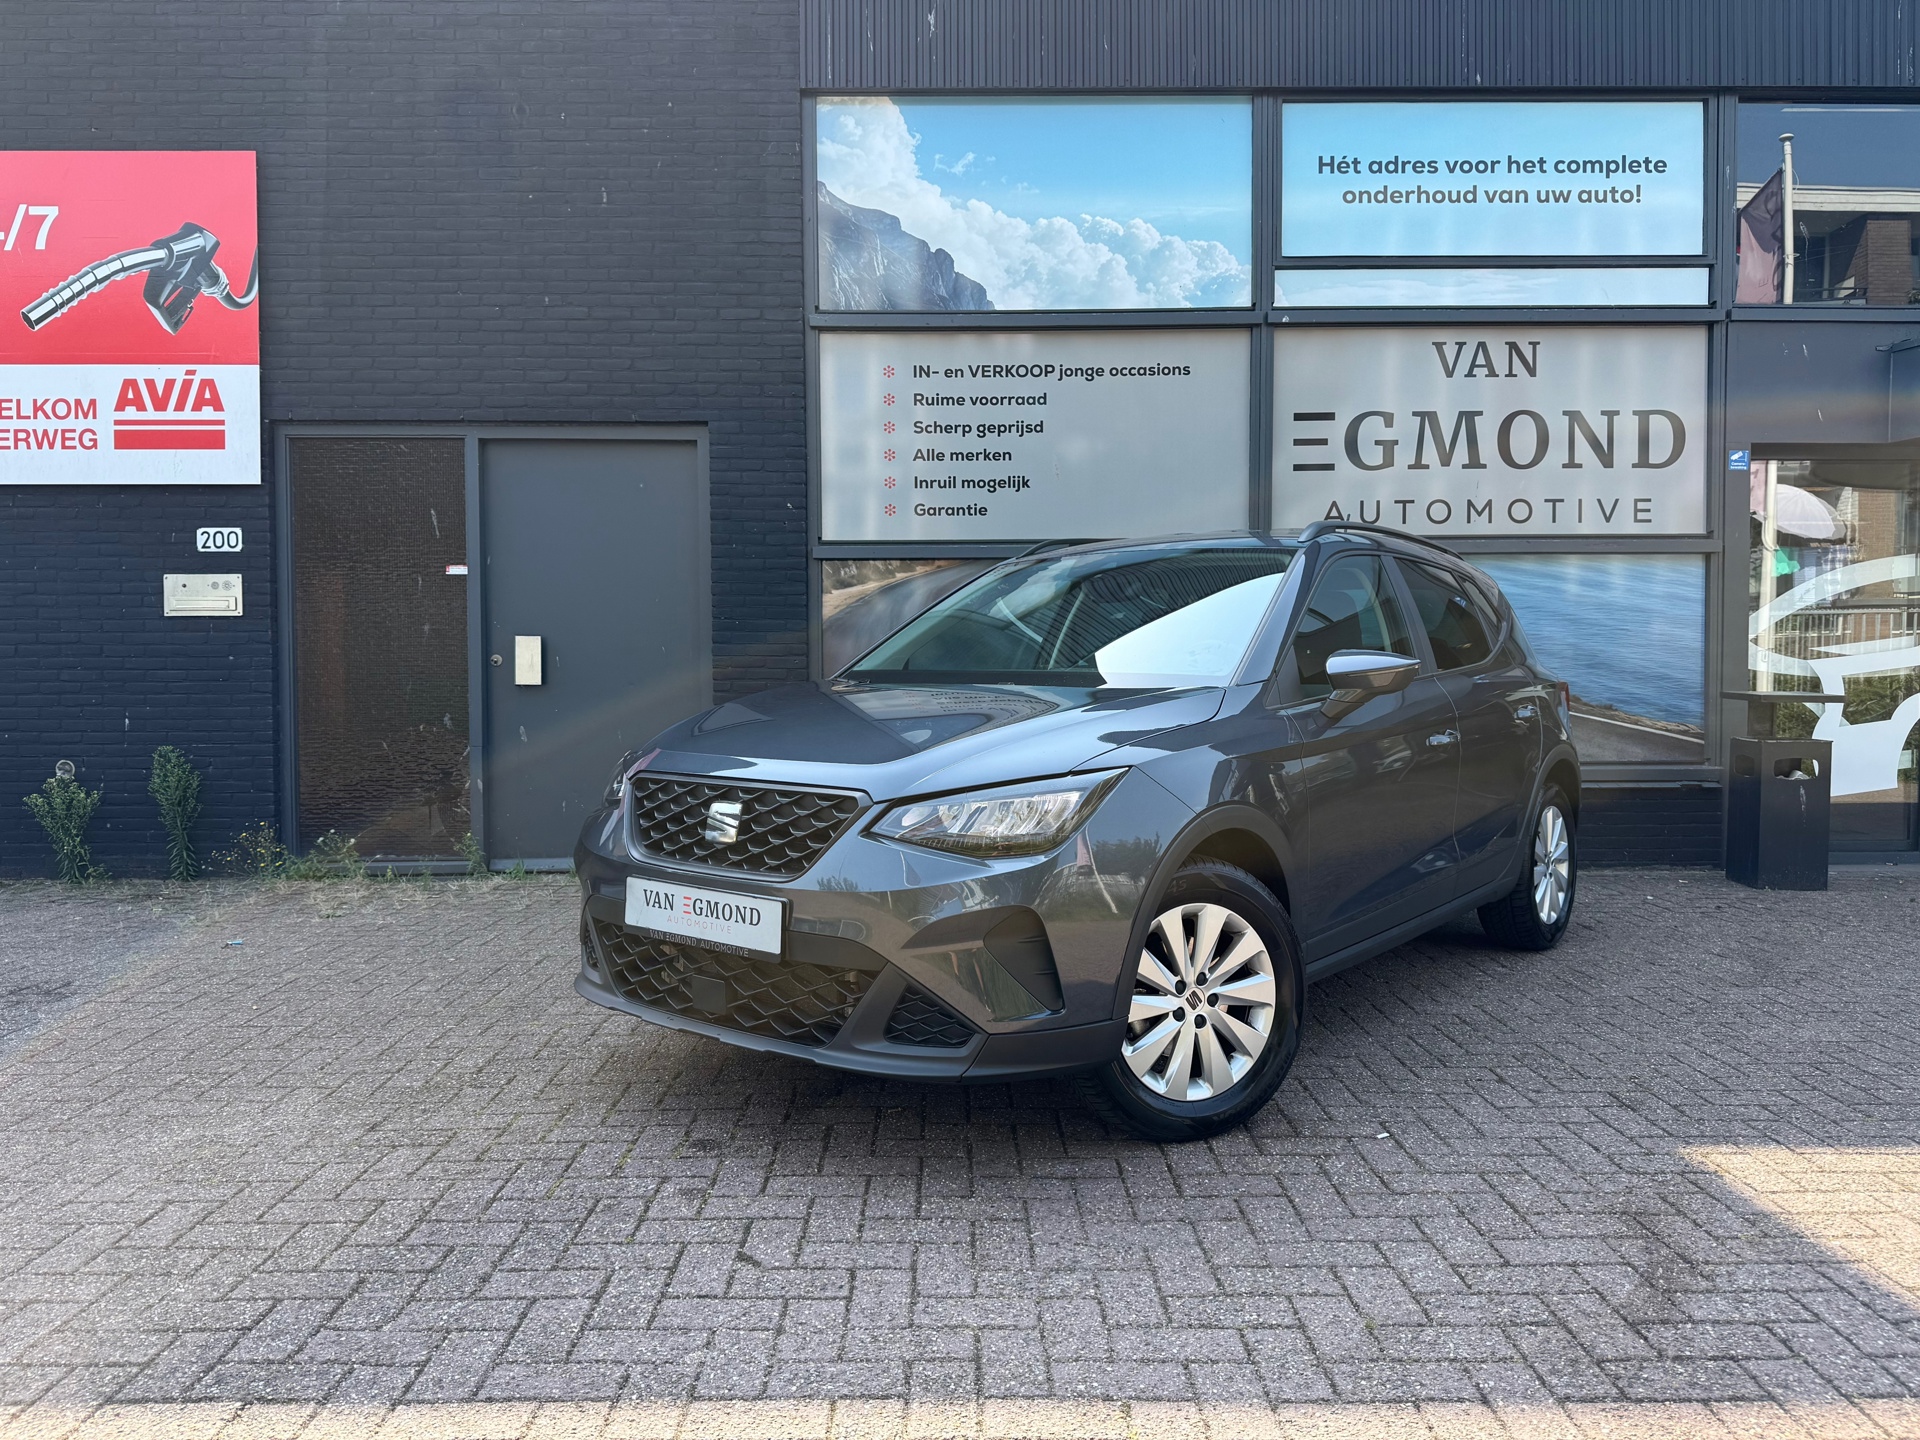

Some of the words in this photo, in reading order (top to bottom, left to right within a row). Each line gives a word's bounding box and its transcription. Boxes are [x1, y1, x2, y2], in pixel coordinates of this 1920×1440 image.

[1318, 155, 1361, 174] Hét
[1367, 154, 1438, 174] adres
[1444, 160, 1501, 174] voor
[1507, 155, 1547, 174] het
[1553, 154, 1668, 180] complete
[1342, 184, 1478, 205] onderhoud
[1483, 190, 1529, 204] van
[1536, 189, 1572, 204] uw
[1577, 184, 1642, 204] auto!
[0, 203, 59, 251] /7
[1431, 341, 1541, 379] VAN
[913, 365, 940, 379] IN-
[944, 368, 964, 379] en
[968, 364, 1056, 379] VERKOOP
[1057, 364, 1105, 382] jonge
[1109, 363, 1191, 378] occasions
[913, 392, 966, 407] Ruime
[969, 392, 1048, 407] voorraad
[913, 420, 973, 438] Scherp
[976, 420, 1044, 439] geprijsd
[1293, 409, 1686, 471] EGMOND
[913, 448, 946, 462] Alle
[949, 448, 1012, 462] merken
[914, 475, 957, 490] Inruil
[961, 475, 1031, 494] mogelijk
[914, 502, 988, 517] Garantie
[1323, 498, 1653, 526] AUTOMOTIVE
[200, 531, 239, 550] 200
[643, 889, 675, 911] VAN
[683, 896, 761, 926] EGMOND
[667, 915, 732, 934] AUTOMOTIVE
[649, 929, 664, 940] VAN
[666, 932, 697, 946] EGMOND
[700, 940, 750, 957] AUTOMOTIVE
